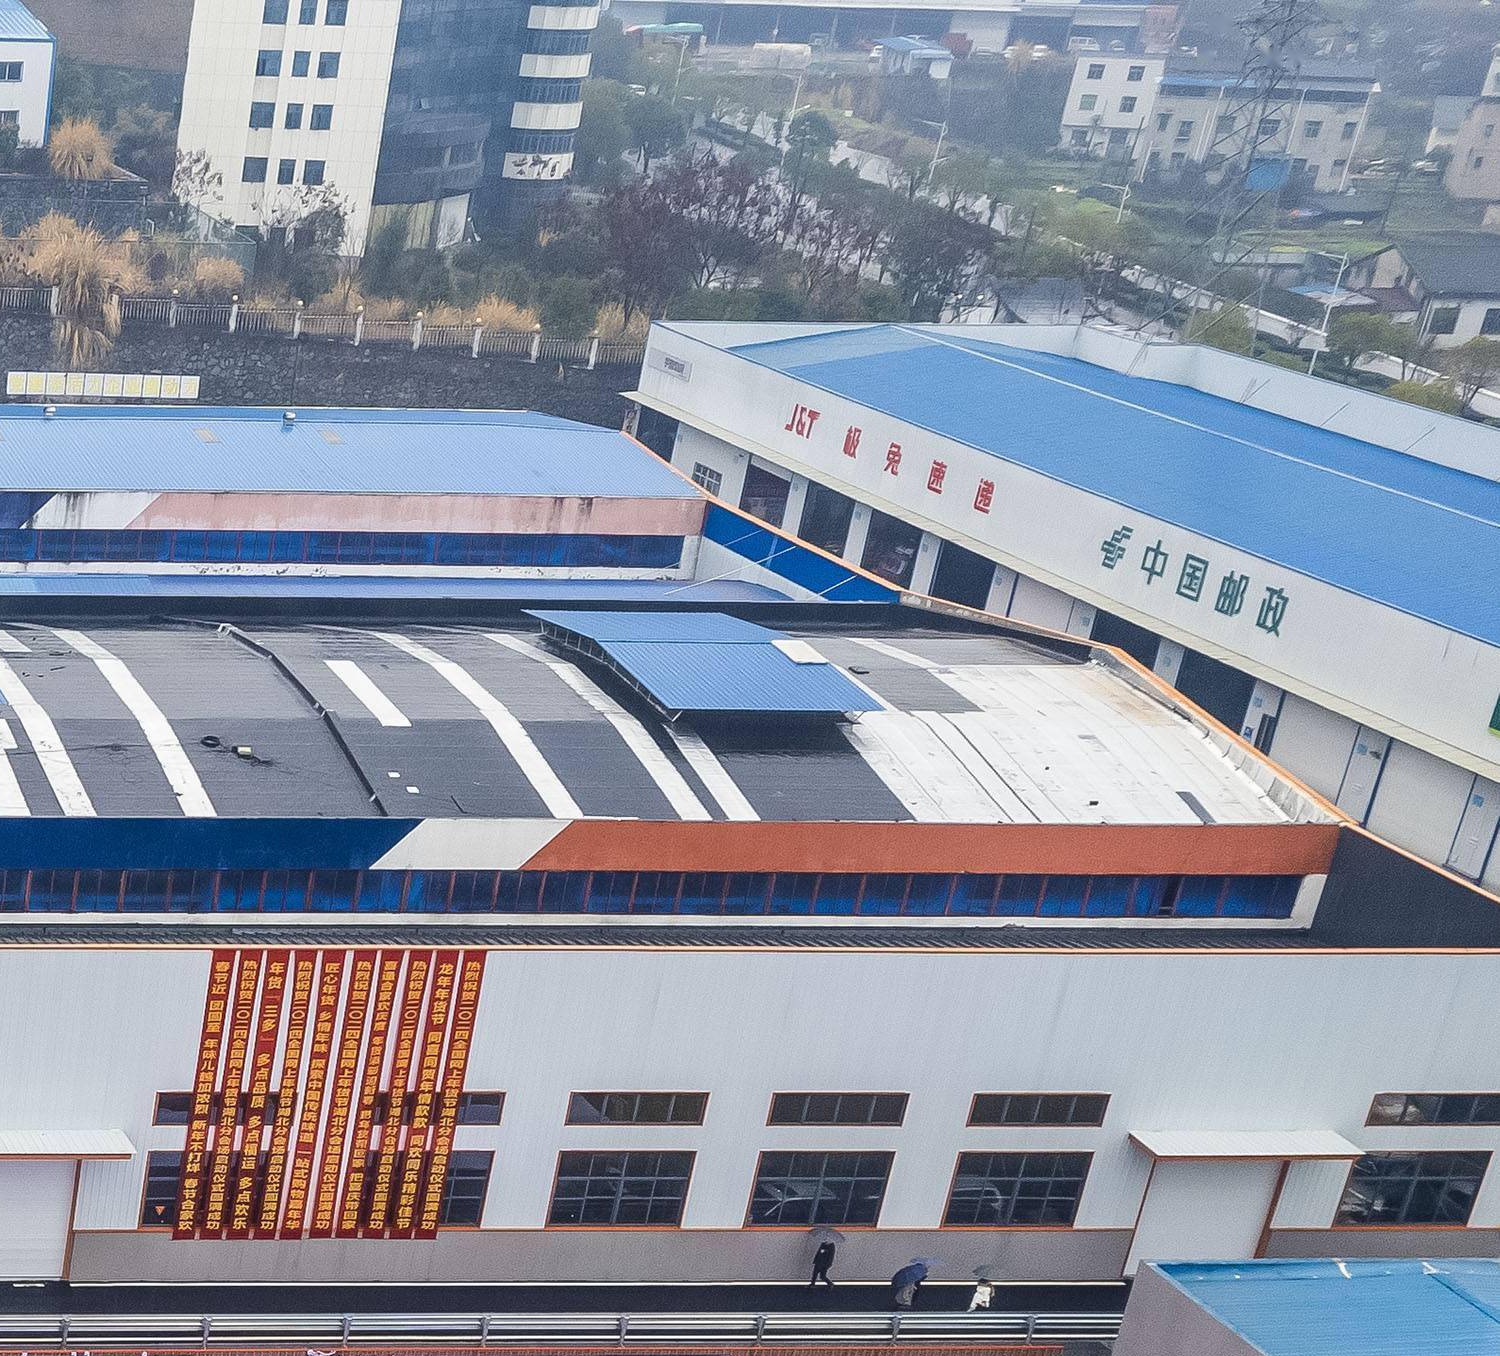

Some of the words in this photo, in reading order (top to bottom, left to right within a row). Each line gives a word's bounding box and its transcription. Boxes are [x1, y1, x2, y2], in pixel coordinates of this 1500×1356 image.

[784, 403, 820, 439] J&T
[842, 425, 996, 515] 极兔速递
[1141, 538, 1290, 638] 中国邮政
